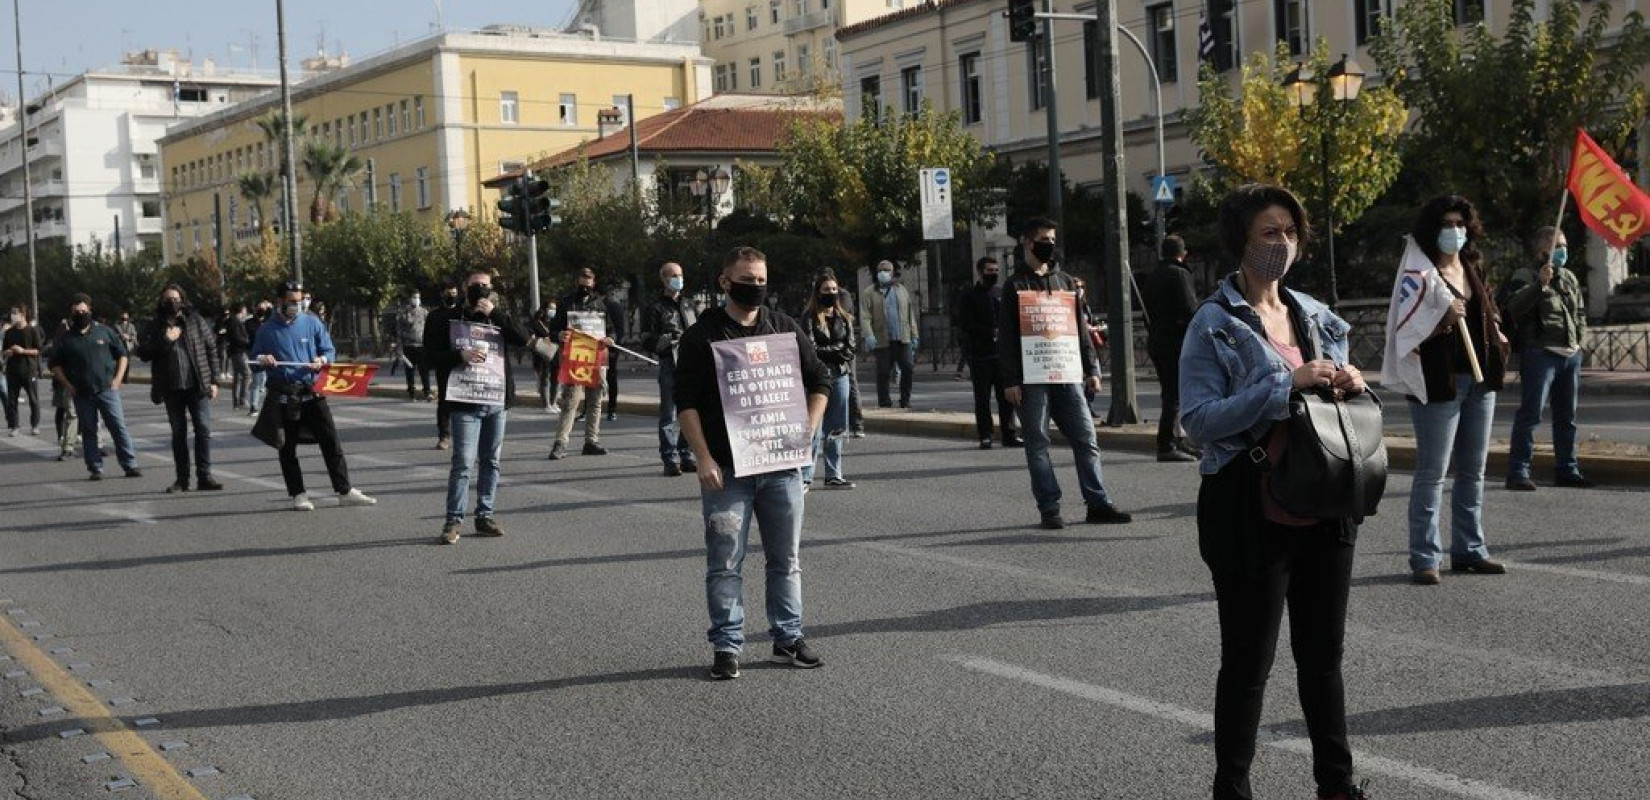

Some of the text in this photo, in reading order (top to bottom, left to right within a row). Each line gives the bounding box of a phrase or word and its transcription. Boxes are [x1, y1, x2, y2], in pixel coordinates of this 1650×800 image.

[727, 364, 792, 382] ΕΞΩ ΤΟ ΝΑΤΟ
[730, 378, 795, 395] ΝΑ ΦΥΓΟΥΝΕ
[740, 392, 790, 407] ΟΙ ΒΑΣΕΙΣ
[750, 411, 787, 425] ΚΑΜΙΑ
[738, 423, 802, 441] ΣΥΜΜΕΤΟΧΗ
[761, 438, 784, 451] ΣΤΙΣ
[742, 449, 805, 468] ΕΠΕΜΒΑΣΕΙΣ
